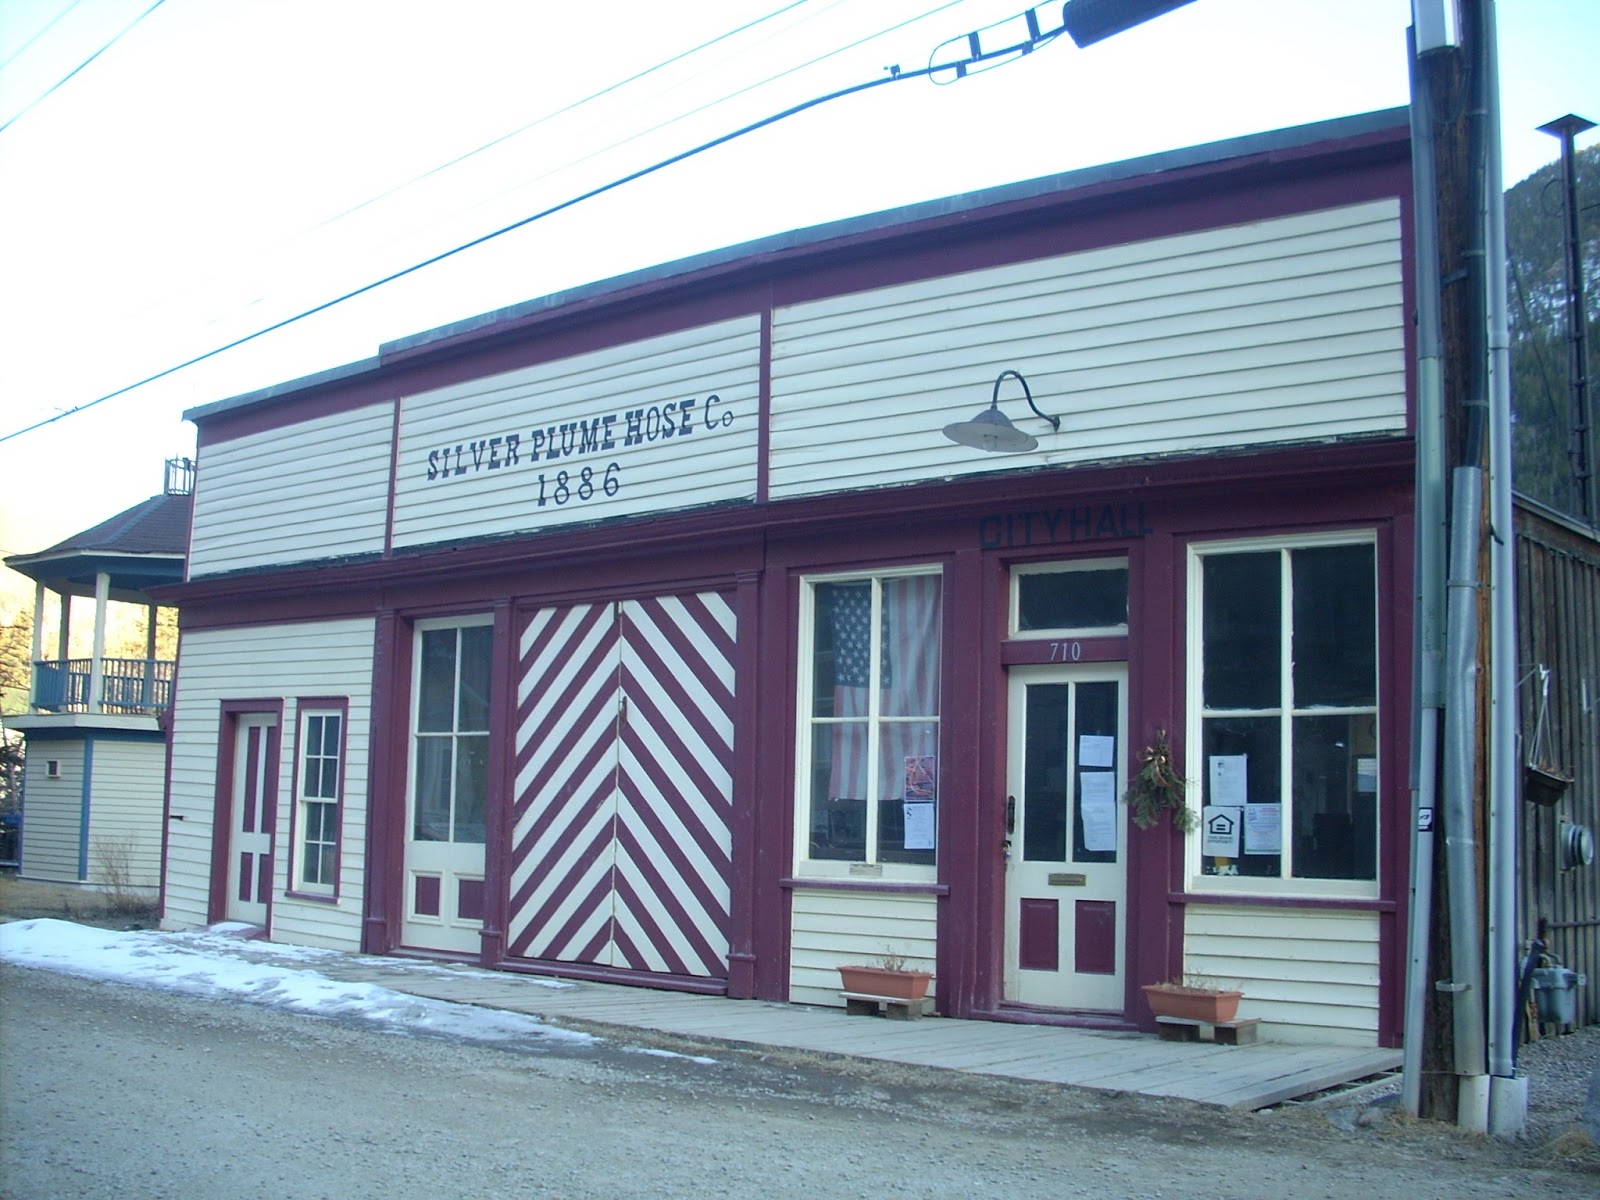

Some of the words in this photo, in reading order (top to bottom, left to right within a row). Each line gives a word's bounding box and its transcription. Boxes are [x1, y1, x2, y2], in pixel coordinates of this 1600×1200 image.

[427, 433, 520, 481] SILVER
[530, 414, 617, 462] PLUME
[623, 398, 696, 447] HOSE
[537, 462, 621, 507] 1886
[980, 508, 1065, 550] CITY
[1069, 501, 1153, 544] HALL
[1050, 641, 1081, 662] 710
